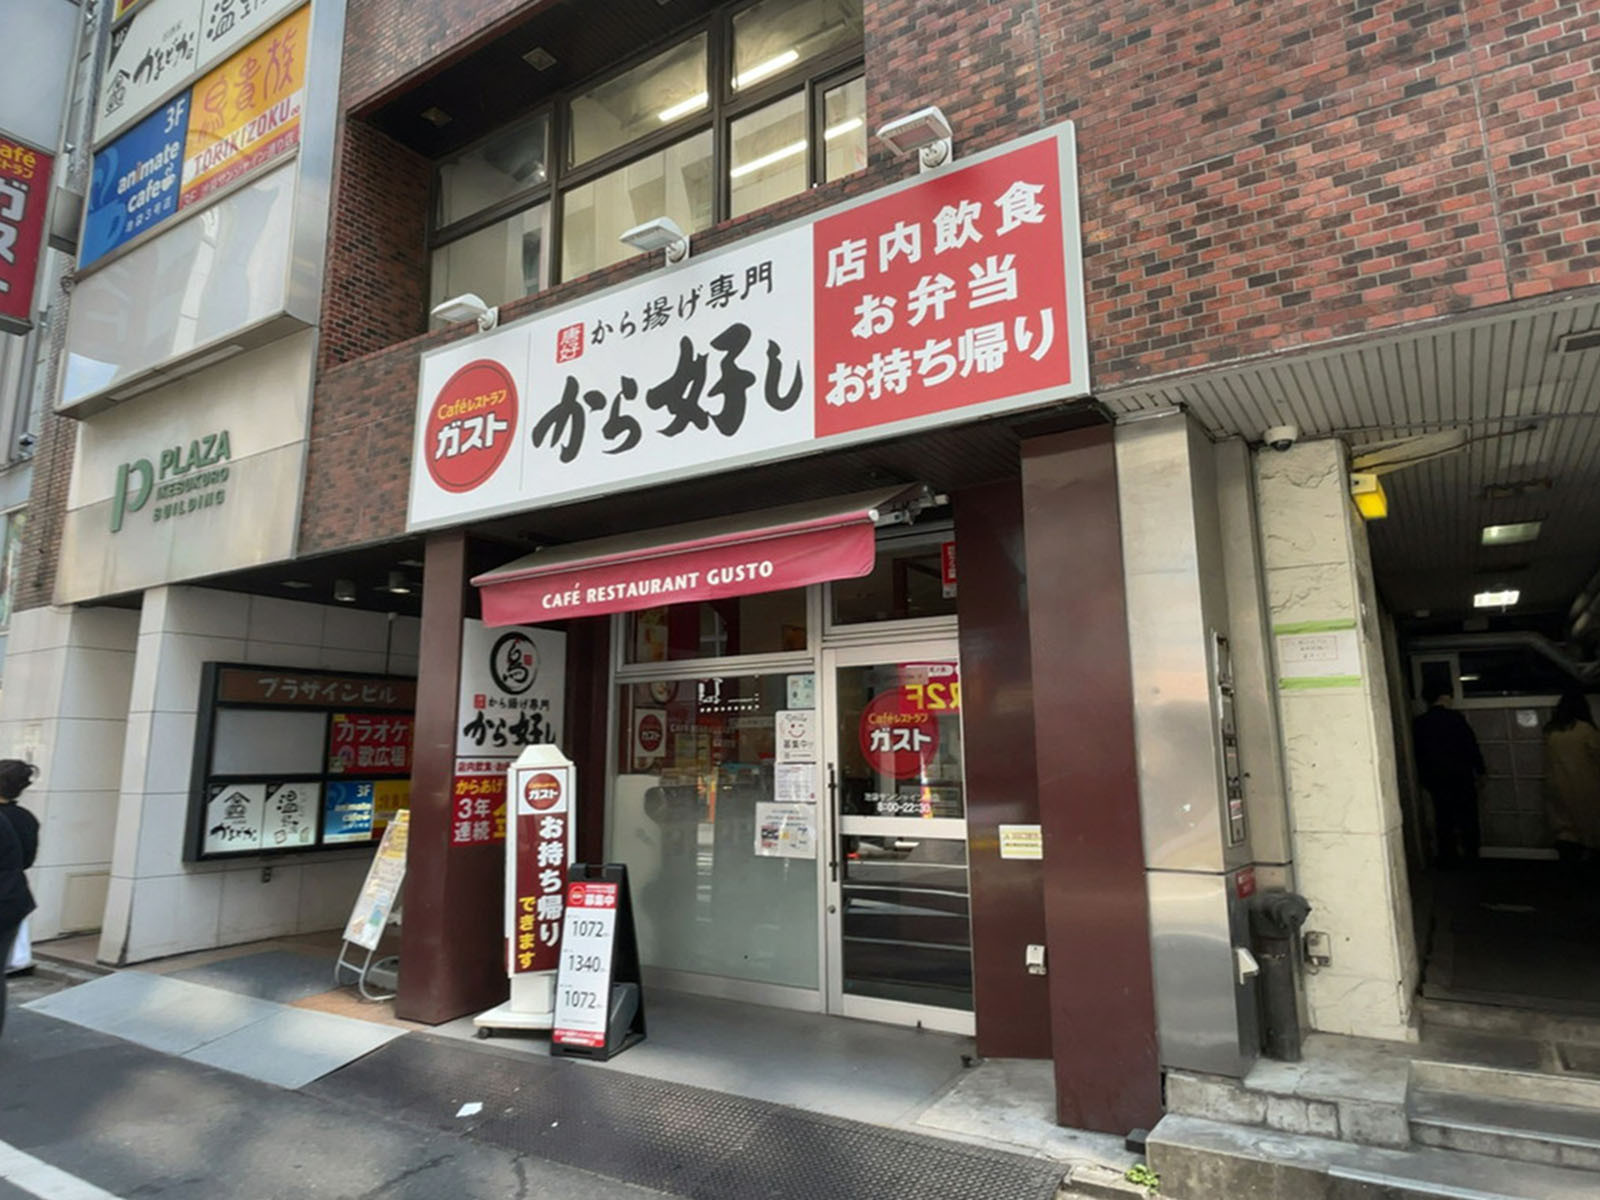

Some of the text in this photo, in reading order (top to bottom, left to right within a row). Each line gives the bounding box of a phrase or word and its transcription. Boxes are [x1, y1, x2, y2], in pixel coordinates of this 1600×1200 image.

[164, 99, 186, 133] 3F
[0, 144, 36, 168] afé
[0, 159, 34, 179] トラン
[117, 141, 180, 194] animate
[127, 177, 160, 213] cafe
[825, 180, 1047, 288] 店内飲食
[590, 260, 773, 345] から揚げ専門
[851, 253, 1018, 339] お弁当
[825, 308, 1055, 406] お持ち帰り
[531, 322, 803, 463] から好し
[434, 411, 508, 461] ガスト
[159, 430, 231, 480] PLAZA
[153, 490, 226, 522] BUILDING
[542, 560, 774, 609] CAFÉ RESTAURANT GUSTO
[336, 719, 408, 742] カラオケ
[463, 710, 556, 747] から好し
[870, 727, 932, 752] ガスト
[356, 784, 372, 797] 3F
[455, 779, 504, 795] からあげ
[528, 789, 559, 800] ガスト
[457, 798, 491, 818] 3年
[537, 815, 564, 947] お持ち帰り
[518, 896, 535, 969] できます
[573, 920, 604, 938] 1072
[569, 954, 601, 973] 1340
[565, 990, 597, 1009] 1072
